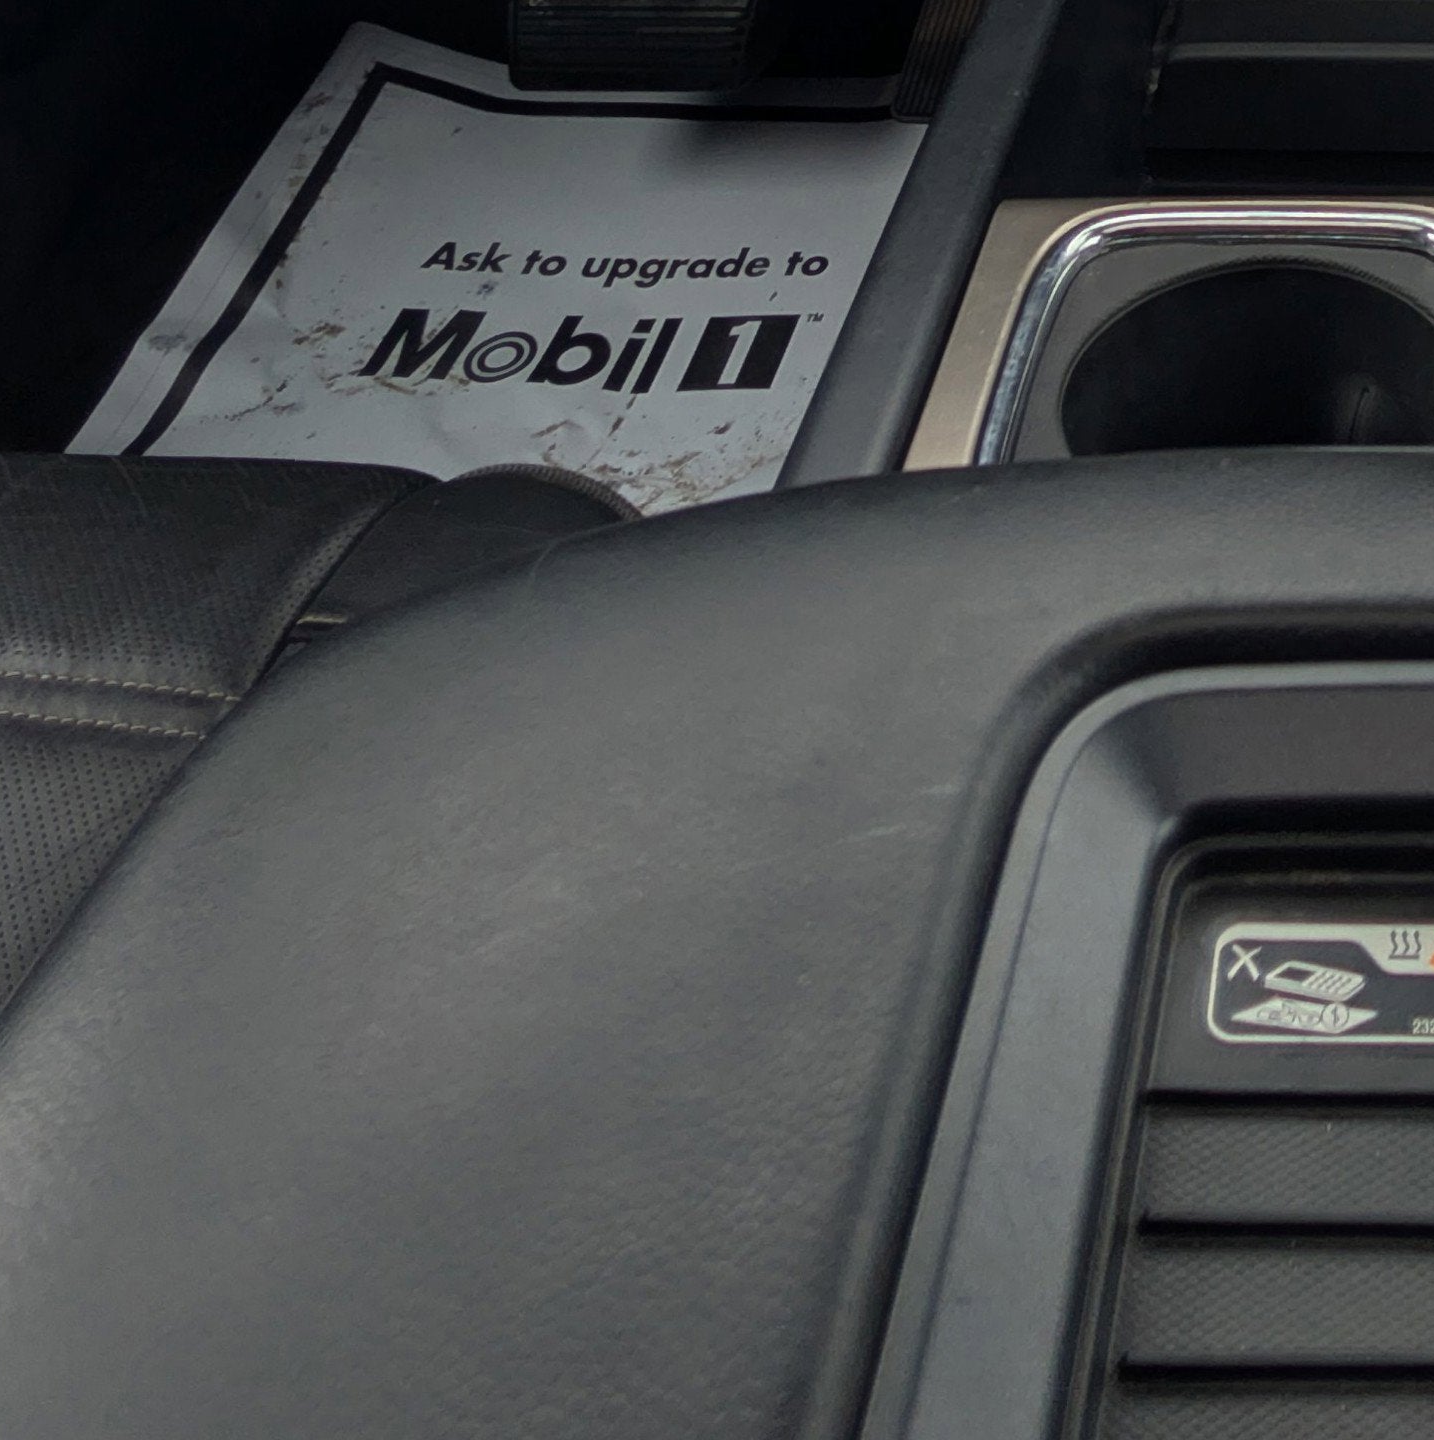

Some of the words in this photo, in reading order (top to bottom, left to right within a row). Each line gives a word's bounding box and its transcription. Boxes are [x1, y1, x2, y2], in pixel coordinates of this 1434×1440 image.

[422, 241, 514, 275] Ask
[521, 247, 567, 276] to
[580, 245, 770, 291] upgrade
[786, 247, 830, 277] to
[359, 308, 684, 394] Mobil
